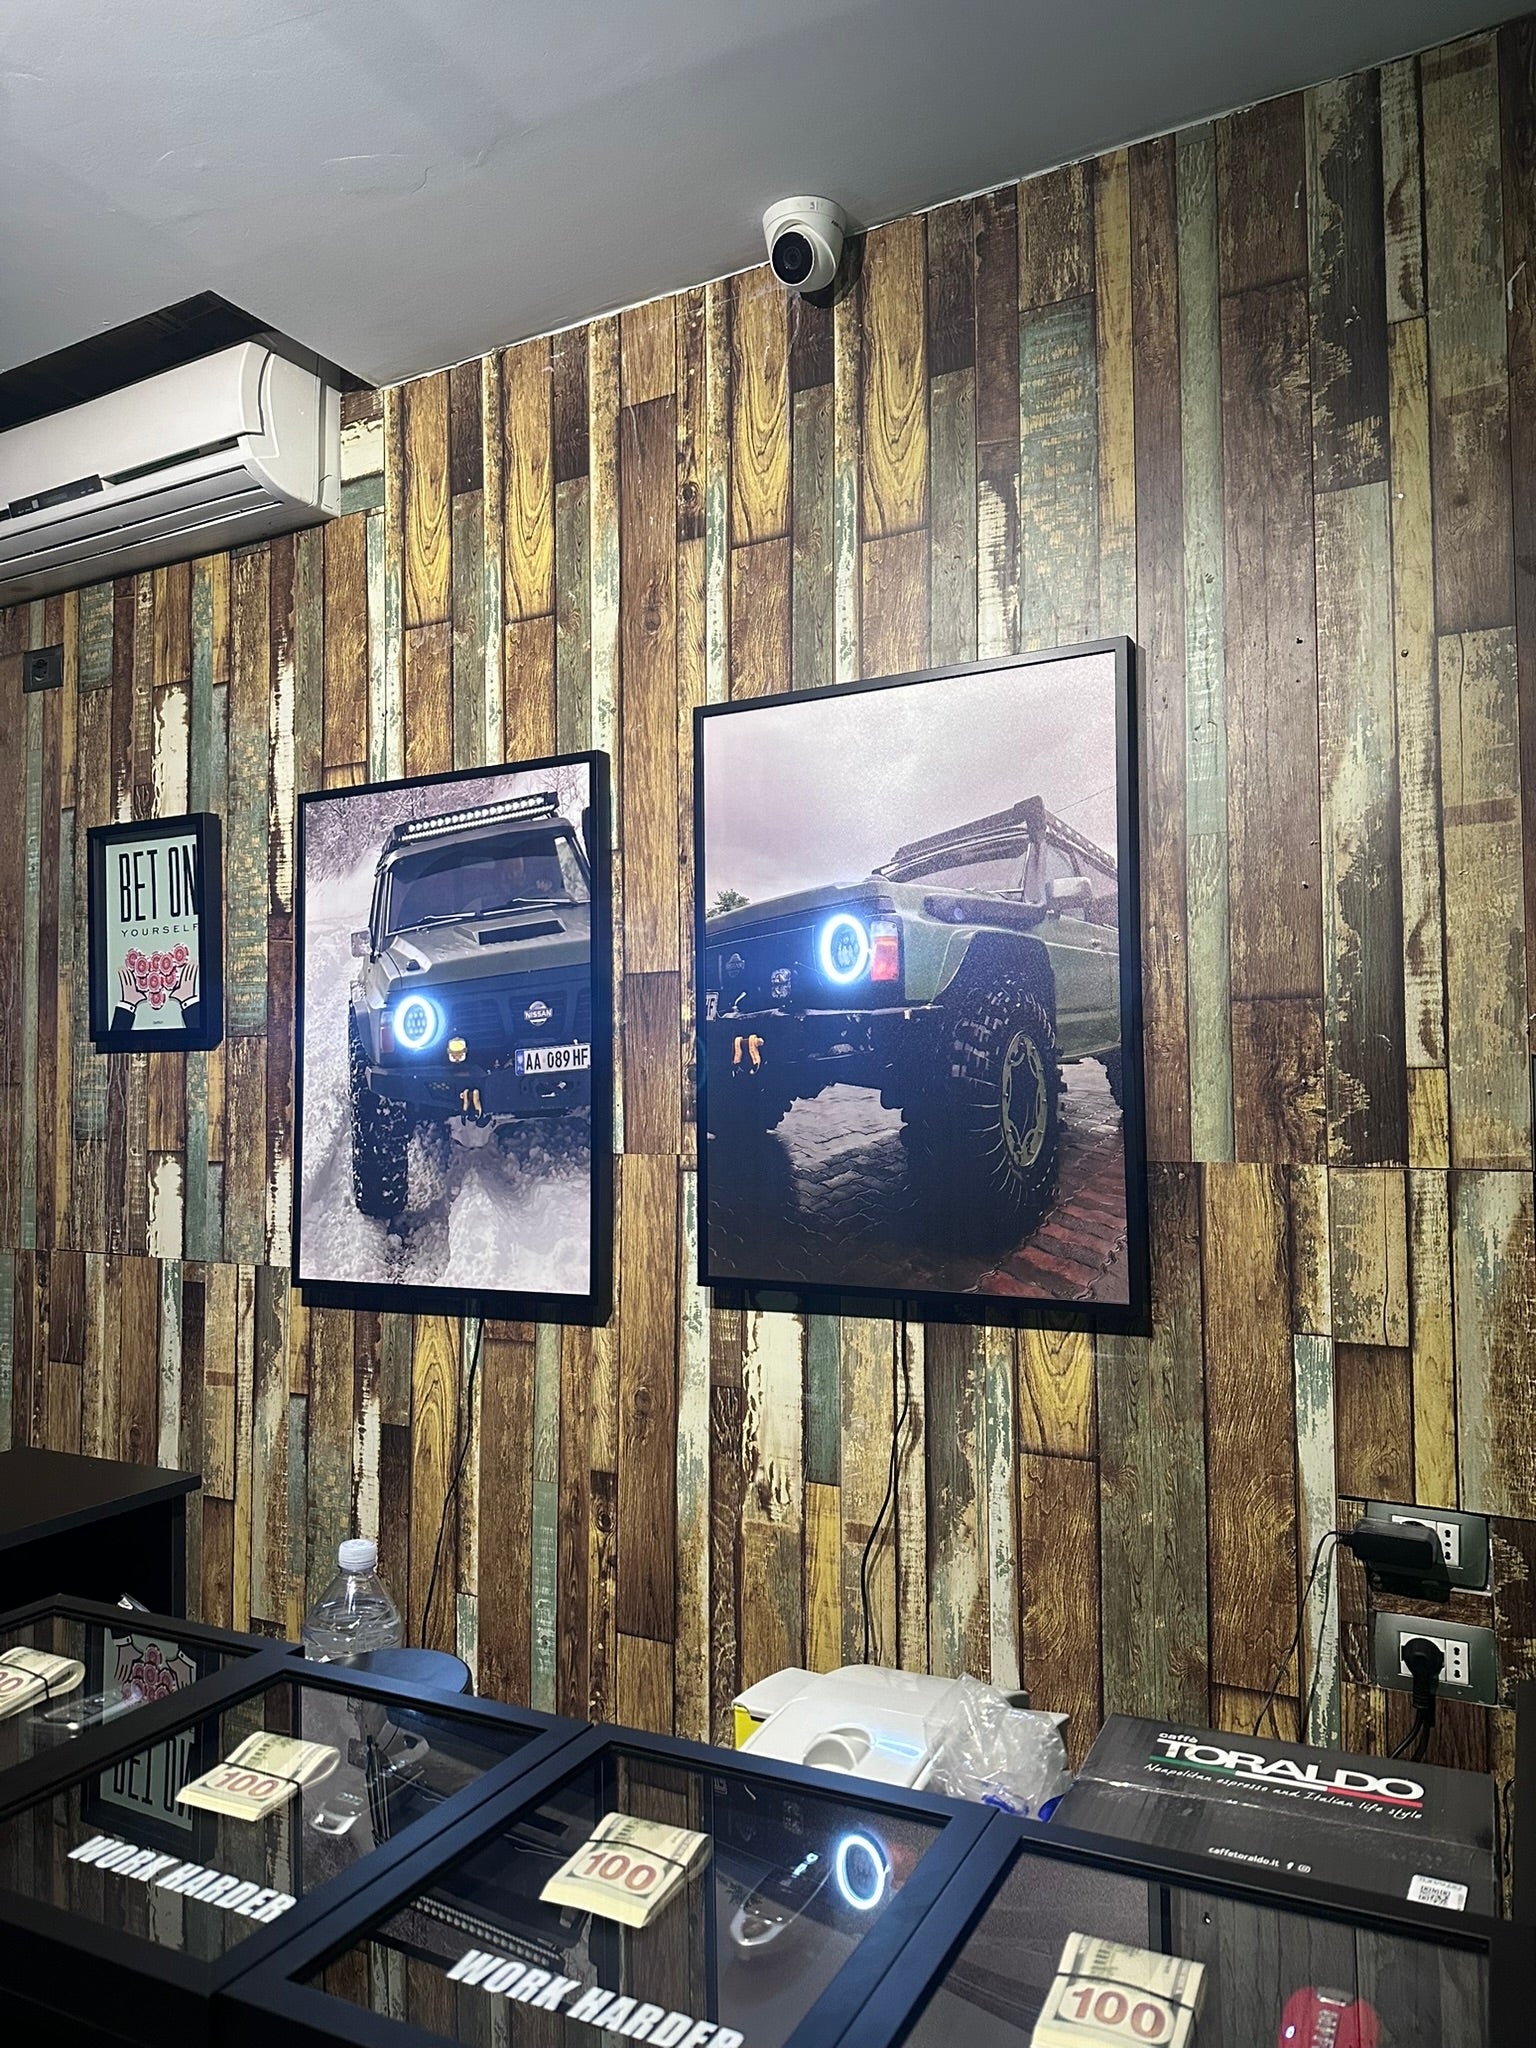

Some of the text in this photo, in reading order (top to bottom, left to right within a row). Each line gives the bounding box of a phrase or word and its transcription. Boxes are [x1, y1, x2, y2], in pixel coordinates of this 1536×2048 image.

[119, 844, 198, 922] BET ON
[121, 923, 198, 937] YOURSELF
[524, 1008, 552, 1020] NISSAN
[526, 1048, 589, 1071] AA 089 HF
[213, 1771, 280, 1798] 100
[1144, 1763, 1423, 1820] Neapolitan espresso and Italian life style
[1156, 1738, 1425, 1800] TORALDO
[67, 1834, 297, 1924] WORK HARDER
[583, 1852, 657, 1891] 100
[1207, 1846, 1280, 1868] caffetoraldo.it
[446, 1949, 745, 2048] WORK HARDER
[1072, 1987, 1166, 2039] 100
